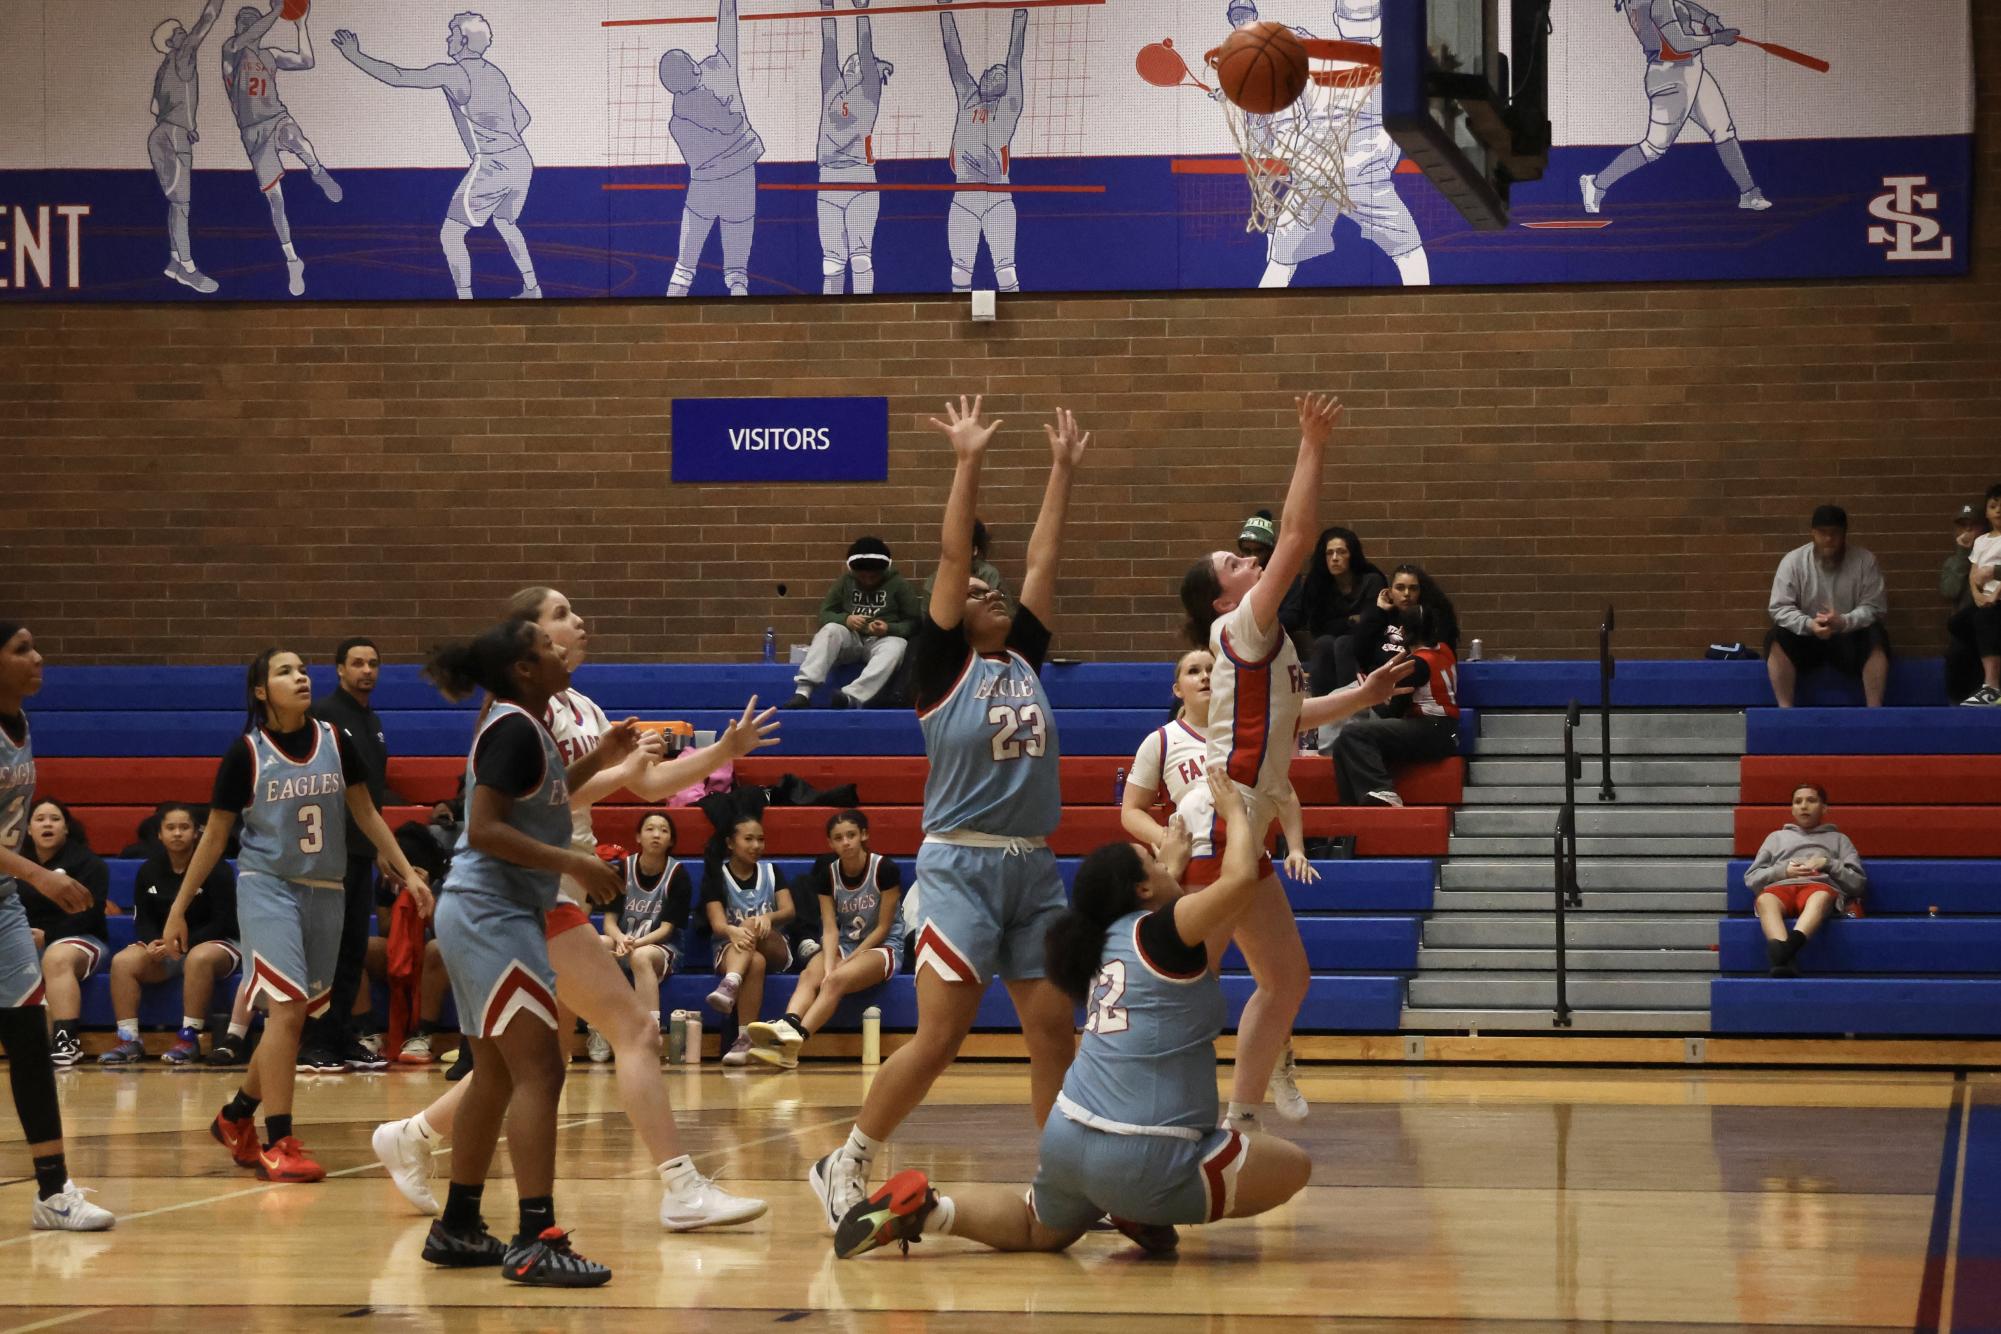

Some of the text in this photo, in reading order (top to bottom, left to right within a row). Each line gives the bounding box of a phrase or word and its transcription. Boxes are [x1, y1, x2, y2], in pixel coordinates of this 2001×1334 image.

[248, 77, 267, 97] 21
[0, 204, 91, 288] NT
[728, 427, 831, 451] VISITORS
[988, 703, 1046, 761] 23
[265, 772, 341, 802] EAGLES
[297, 803, 324, 855] 3
